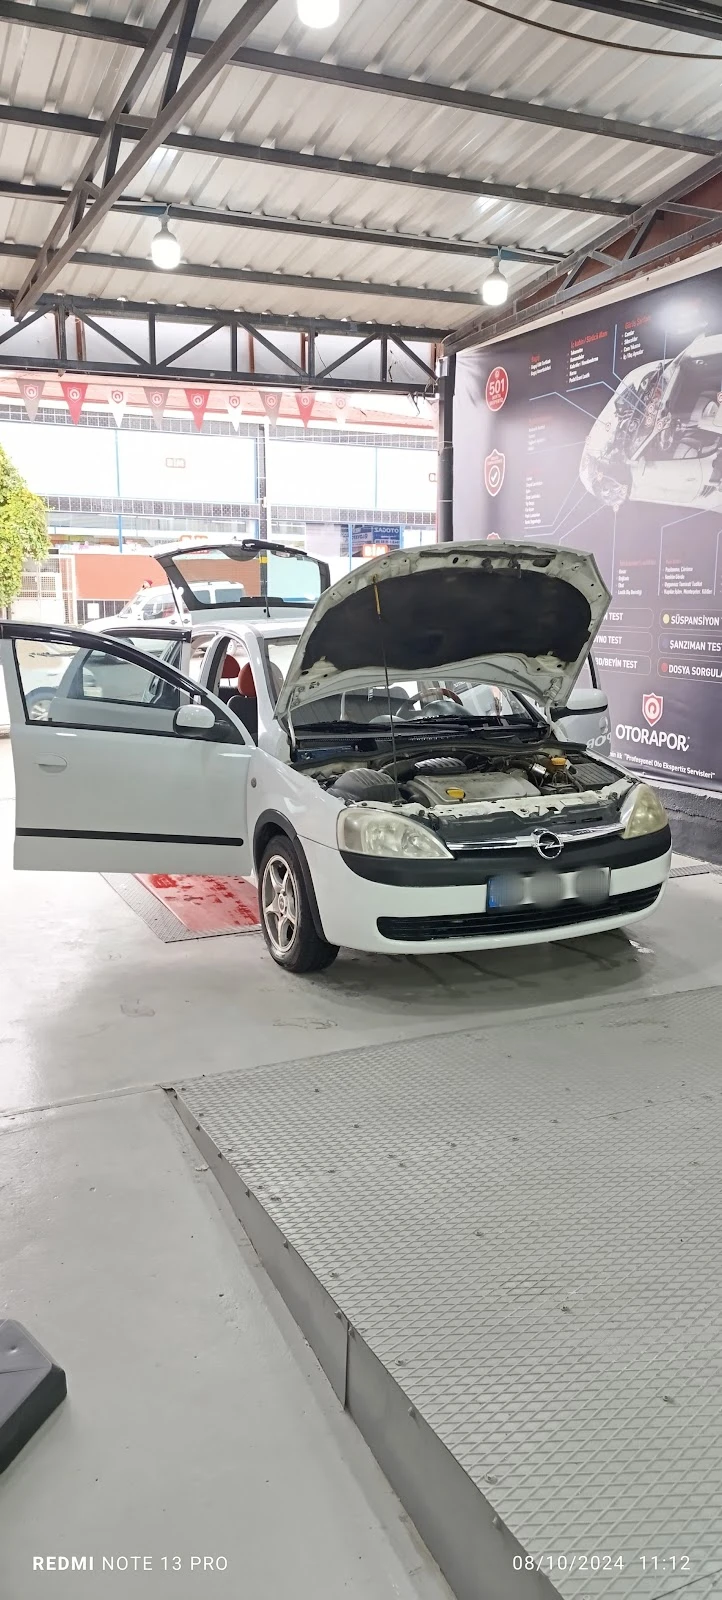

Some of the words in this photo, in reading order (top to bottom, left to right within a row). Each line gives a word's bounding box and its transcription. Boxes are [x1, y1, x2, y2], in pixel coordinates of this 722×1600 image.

[489, 378, 505, 396] 501
[609, 612, 623, 620] TEST
[671, 614, 720, 626] SÜSPANSİYON
[608, 636, 622, 644] TEST
[669, 640, 706, 651] ŞANZIMAN
[623, 659, 638, 668] TEST
[668, 664, 691, 675] DOSYA
[615, 724, 690, 752] OTORAPOR
[653, 760, 662, 768] Oto
[662, 762, 687, 774] Ekspertiz
